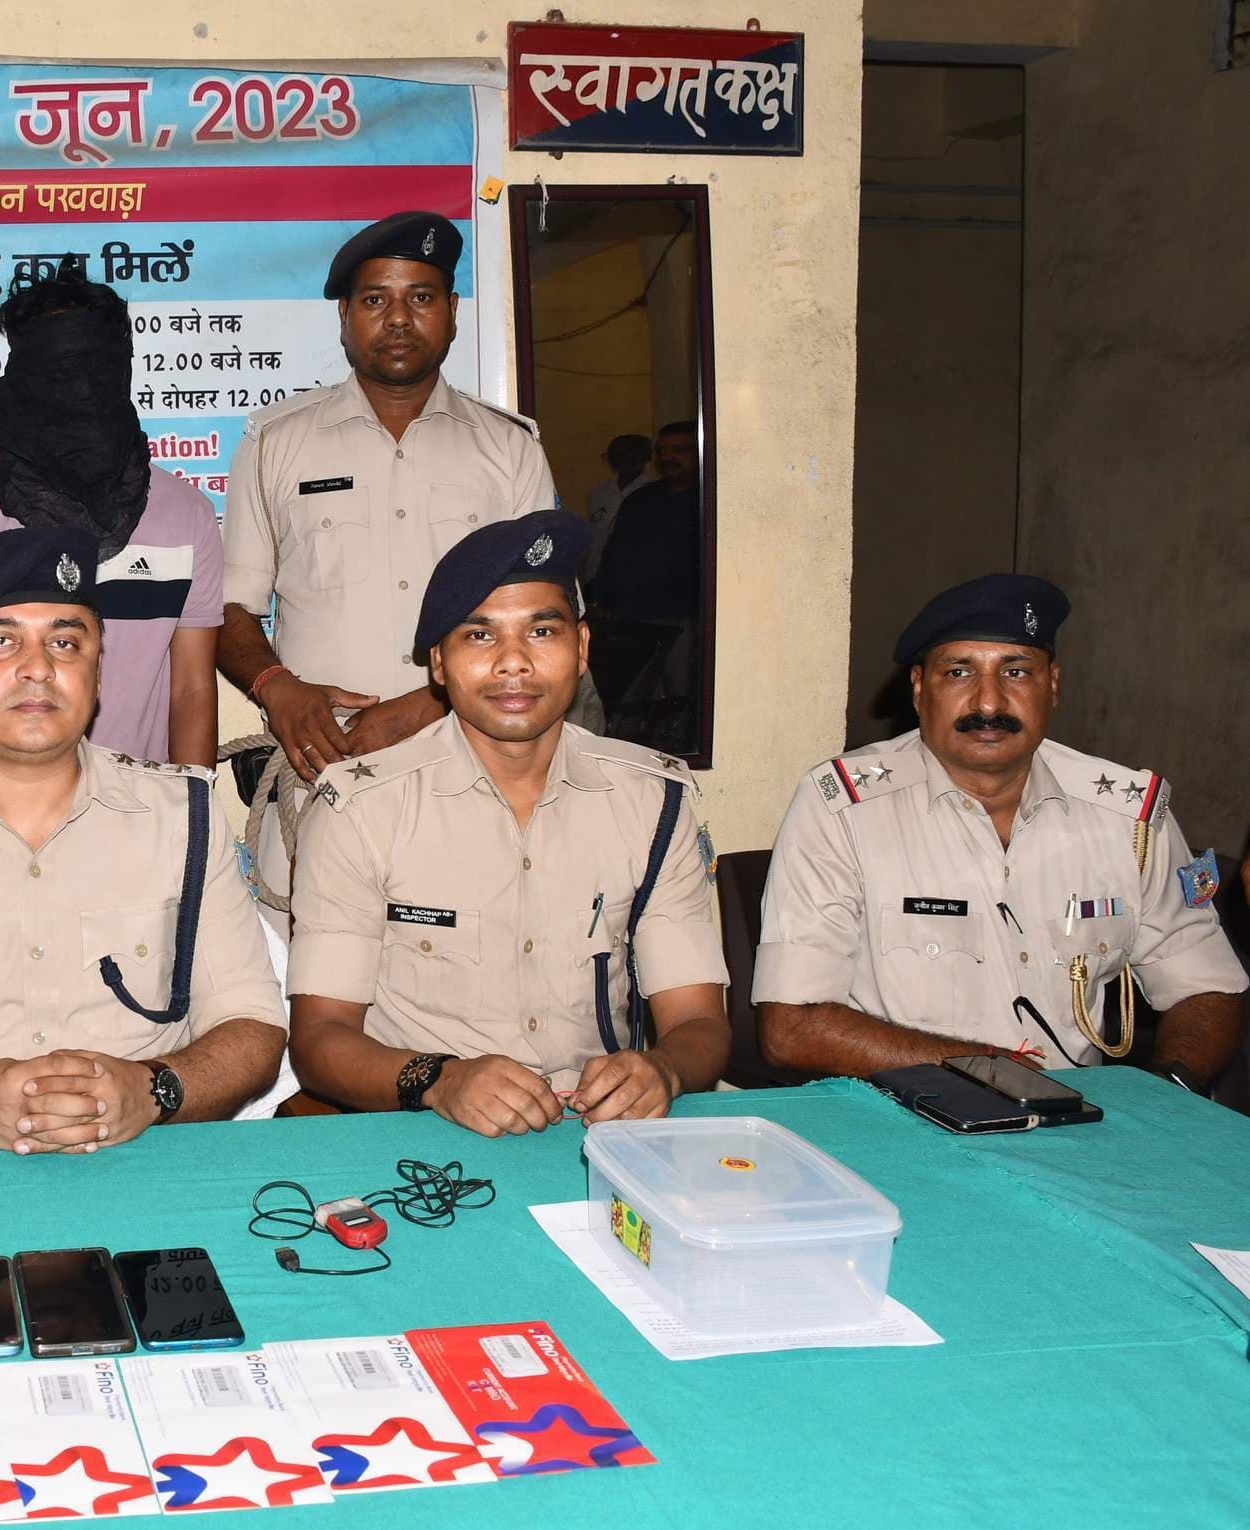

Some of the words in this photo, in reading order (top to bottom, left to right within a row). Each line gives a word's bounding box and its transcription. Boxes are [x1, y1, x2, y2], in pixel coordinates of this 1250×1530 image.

[195, 77, 356, 141] 2023
[520, 53, 713, 138] स्वागत
[714, 59, 798, 131] कक्ष
[38, 182, 146, 219] पखवाड़ा
[101, 239, 195, 284] मिलें
[169, 307, 202, 335] बजे
[208, 314, 243, 334] तक
[142, 352, 203, 372] 12.00
[209, 344, 243, 371] बजे
[248, 351, 283, 371] तक
[137, 383, 155, 410] से
[161, 383, 220, 411] दोपहर
[128, 568, 152, 576] adidas
[400, 914, 437, 923] INSPECTOR
[393, 1347, 413, 1370] Fino
[532, 1334, 559, 1358] Fino
[95, 1369, 114, 1394] Fino
[250, 1361, 269, 1386] Fino
